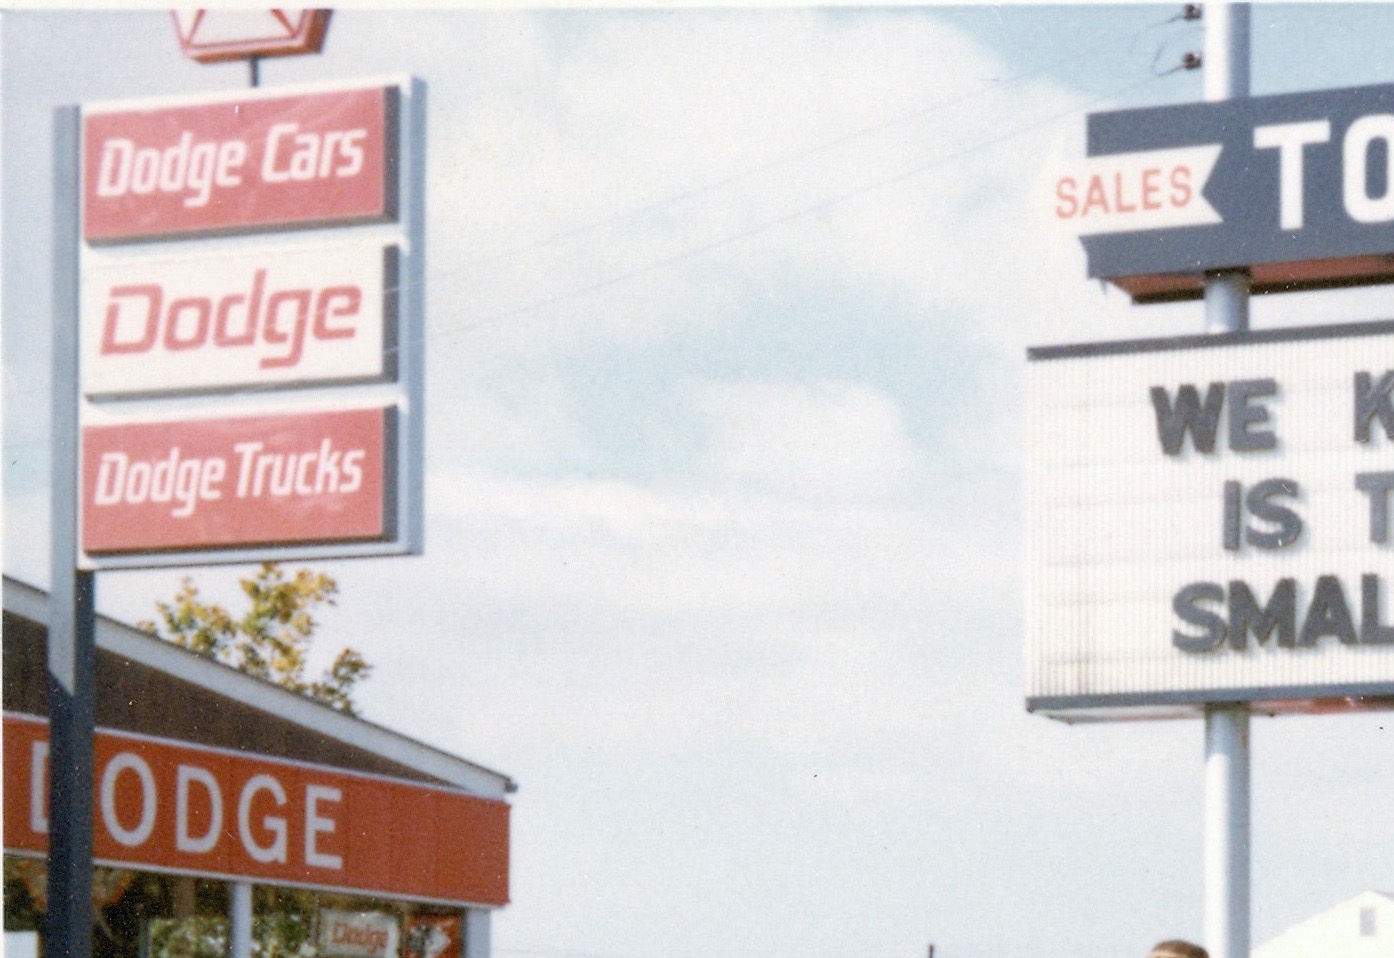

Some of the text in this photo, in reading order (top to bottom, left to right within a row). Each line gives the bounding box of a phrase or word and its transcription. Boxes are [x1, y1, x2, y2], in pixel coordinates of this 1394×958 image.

[98, 123, 366, 207] Dodge Cars
[1055, 165, 1192, 220] SALES
[100, 268, 362, 370] Dodge
[1150, 378, 1278, 456] WE
[95, 438, 365, 518] Dodge Trucks
[1223, 477, 1304, 551] IS
